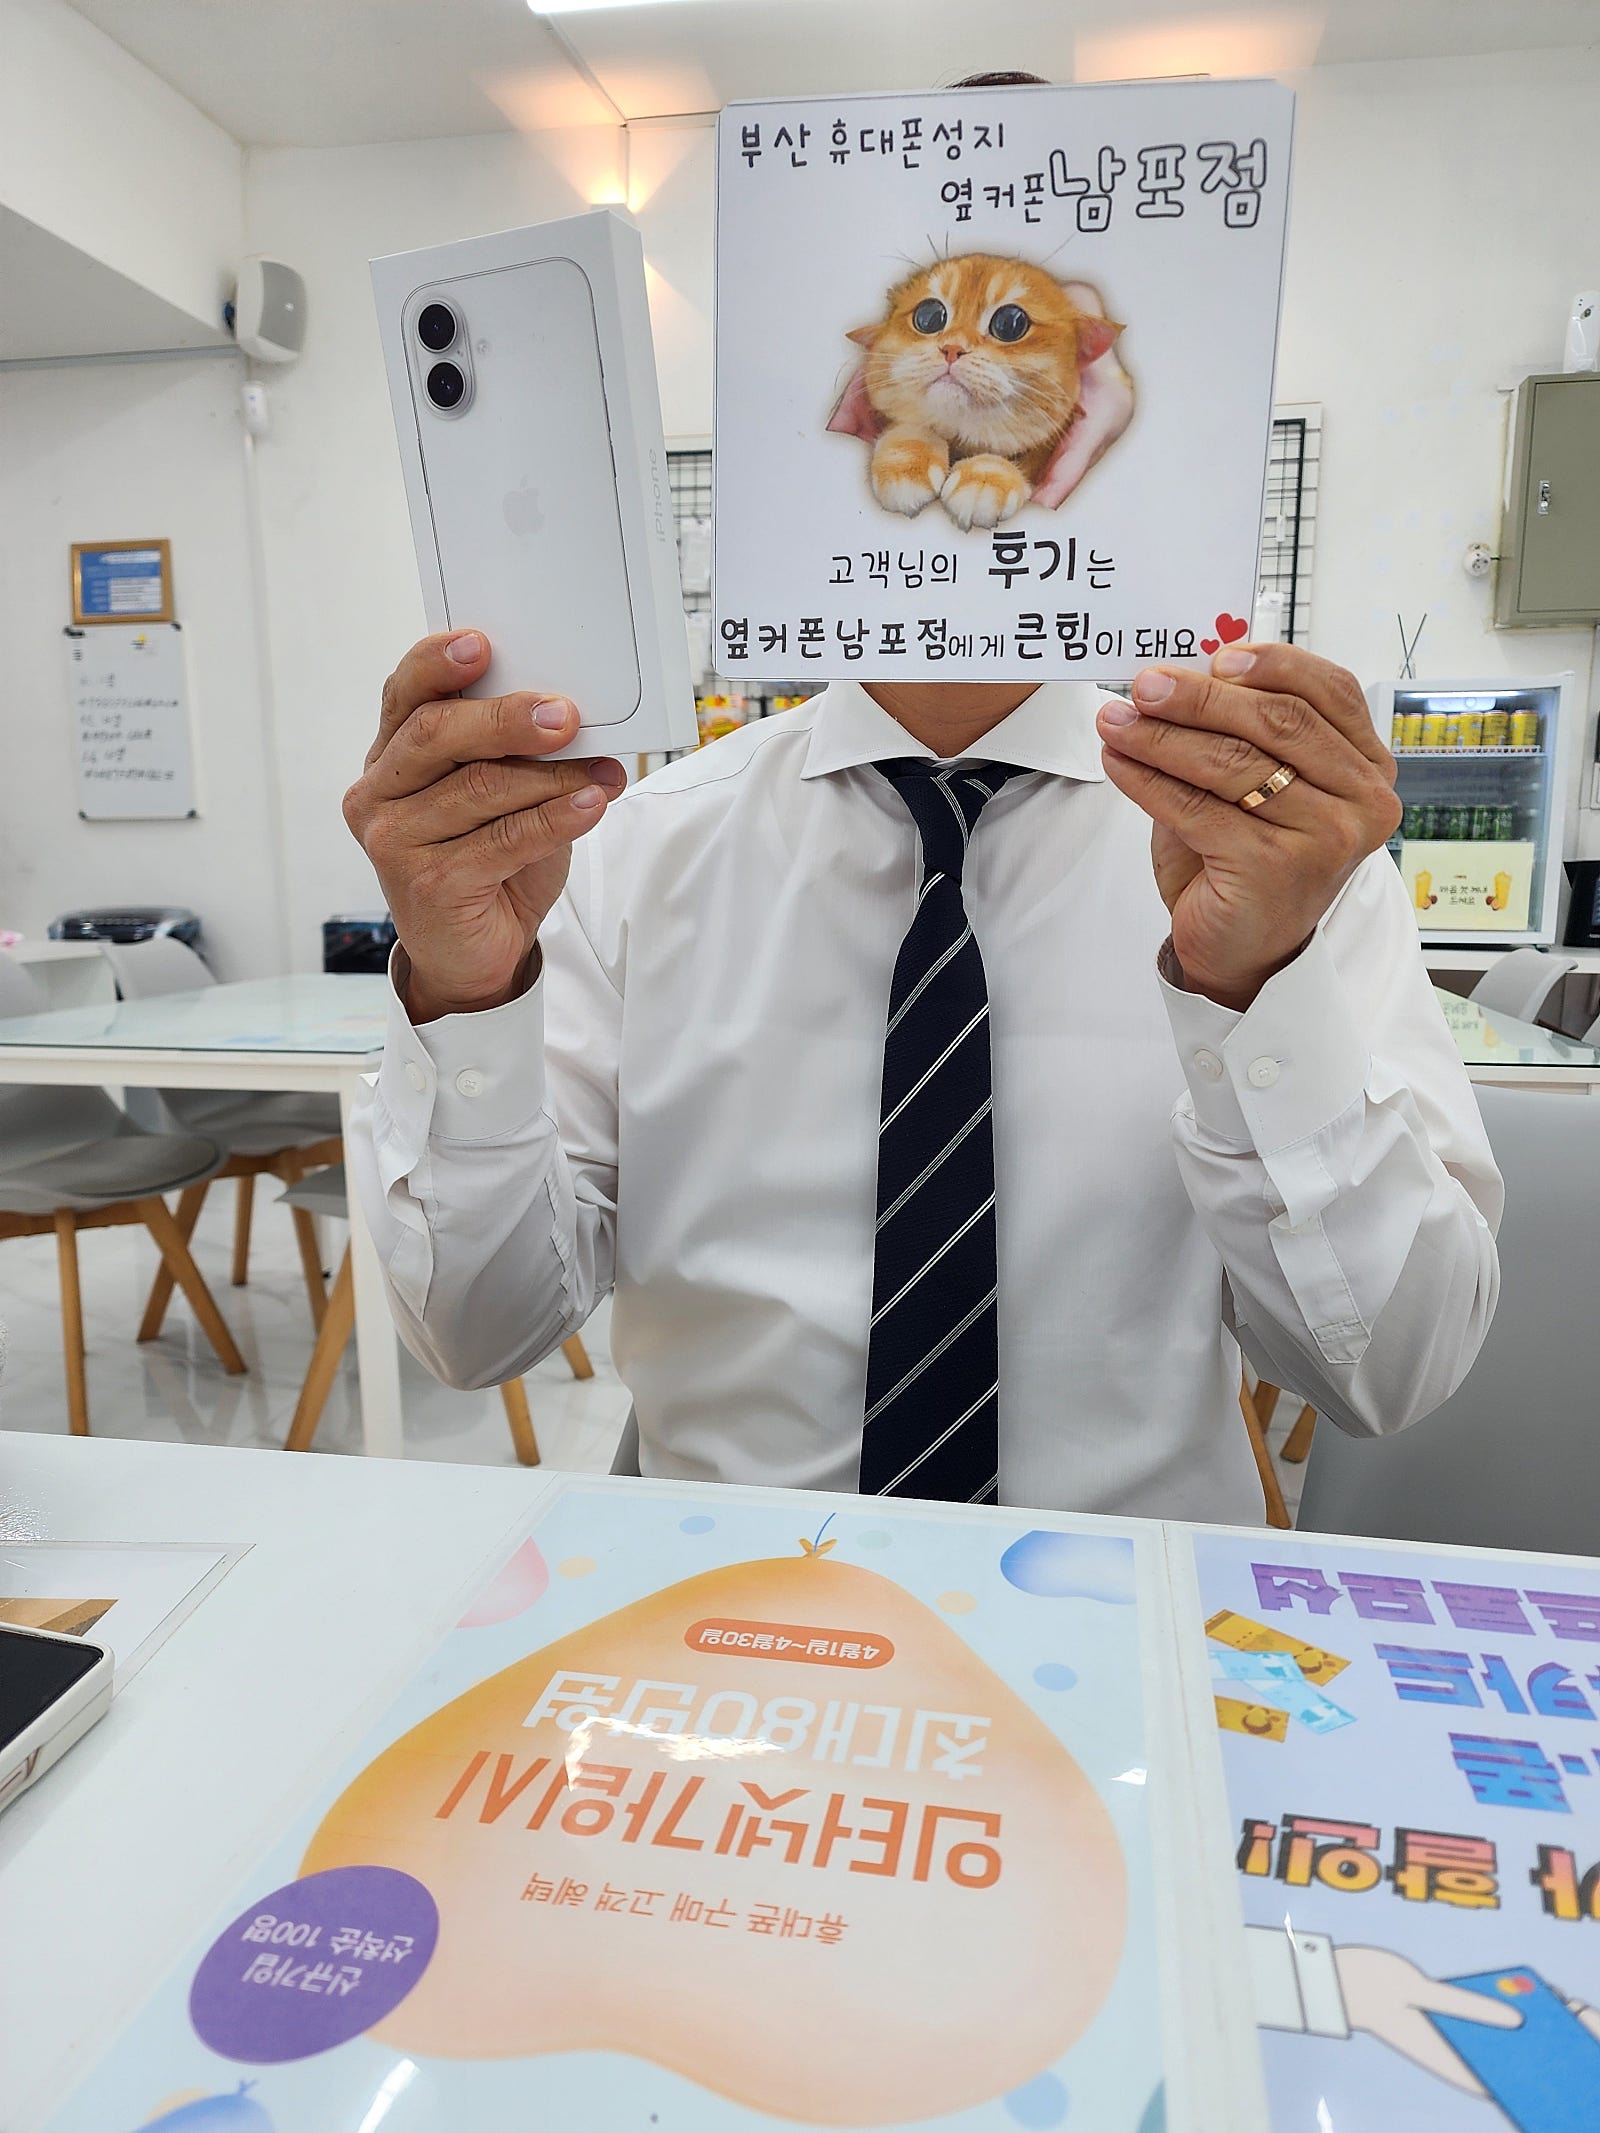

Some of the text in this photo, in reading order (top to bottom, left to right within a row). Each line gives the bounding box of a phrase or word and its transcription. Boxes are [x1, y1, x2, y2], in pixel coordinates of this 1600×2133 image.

[741, 117, 1004, 170] 부산 휴대폰성지
[1048, 137, 1268, 234] 남포점
[648, 447, 667, 543] iPhone
[828, 527, 1116, 590] 고객님의 후기는
[1134, 628, 1198, 659] 돼요
[698, 1627, 881, 1663] 4월1일~4월30일
[520, 1872, 850, 1946] 휴대폰 구매 고객 혜택
[240, 1914, 414, 1964] 선착순 100명
[240, 1953, 362, 1996] 신규가입
